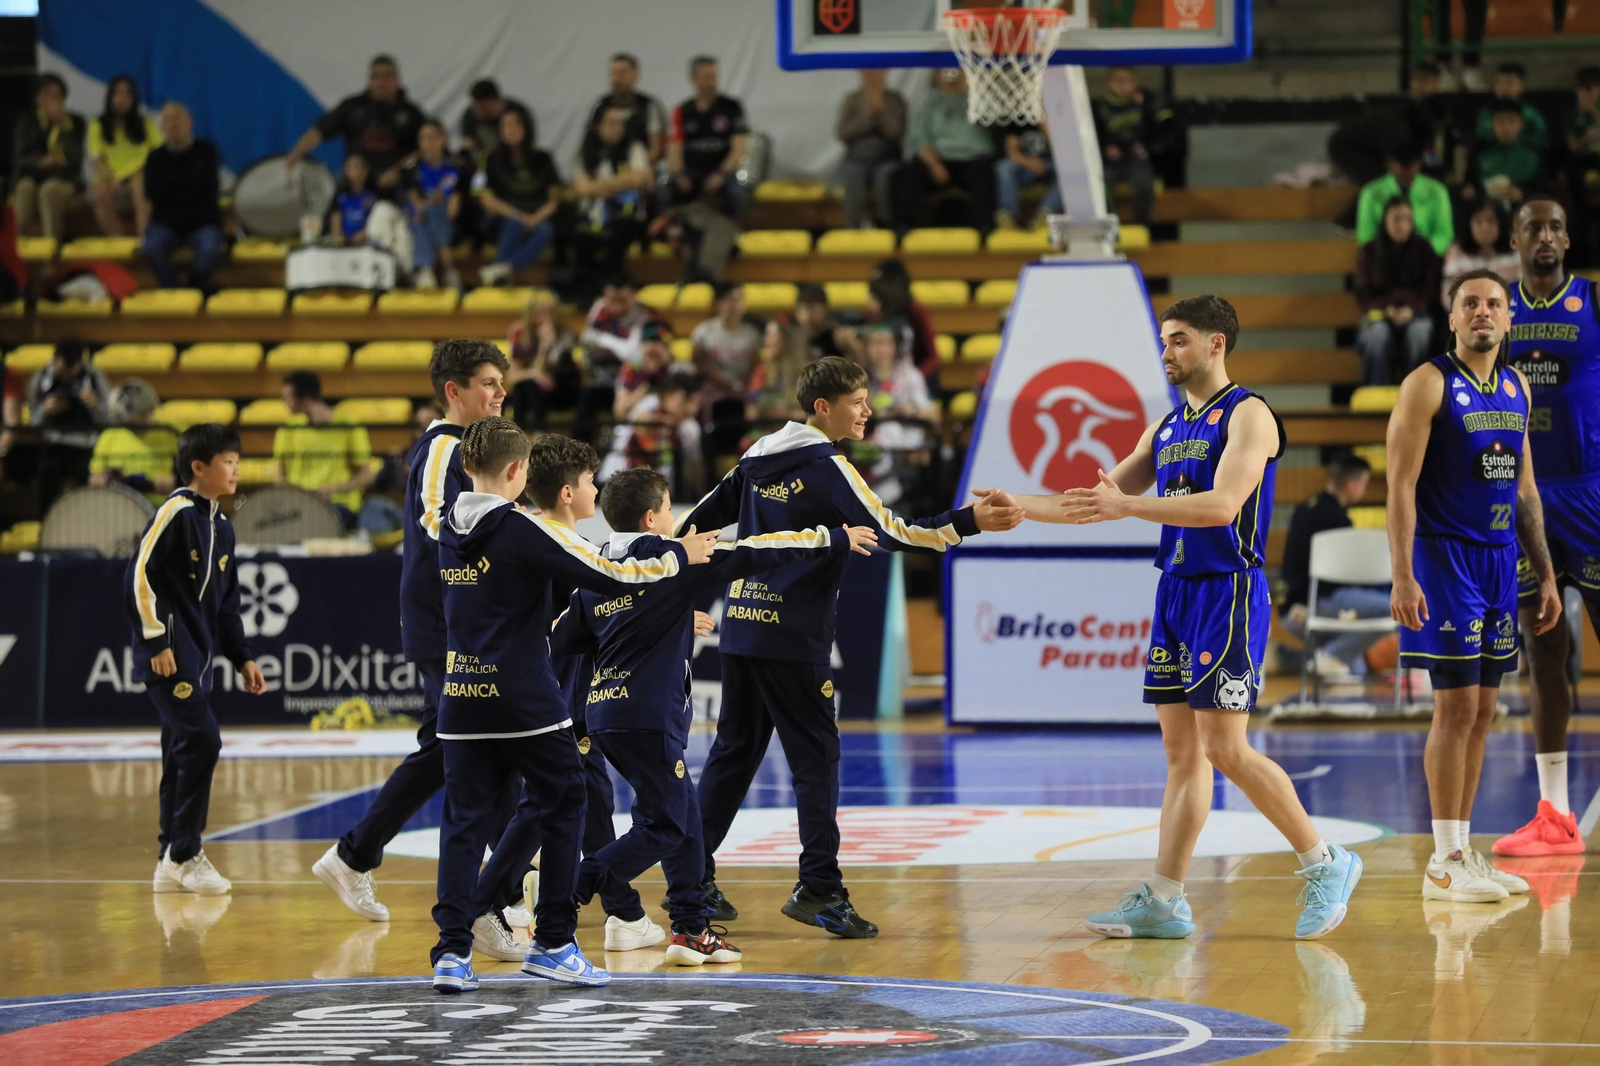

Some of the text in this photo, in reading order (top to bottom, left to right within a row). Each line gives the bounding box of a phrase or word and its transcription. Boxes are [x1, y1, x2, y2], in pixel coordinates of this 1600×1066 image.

[1508, 323, 1580, 342] URENSE
[1526, 373, 1557, 384] alicia
[1463, 411, 1525, 433] OURENSE
[1482, 453, 1515, 466] Estrella
[1484, 466, 1514, 479] Galicia
[1490, 504, 1512, 530] 22
[745, 581, 768, 591] XUNTA
[742, 590, 783, 603] DE GALICIA
[726, 605, 780, 624] ABANCA
[454, 663, 465, 673] DE
[443, 682, 500, 698] ABANCA
[586, 686, 629, 705] ABANCA
[185, 1002, 520, 1066] Galici
[432, 998, 758, 1066] Estrell
